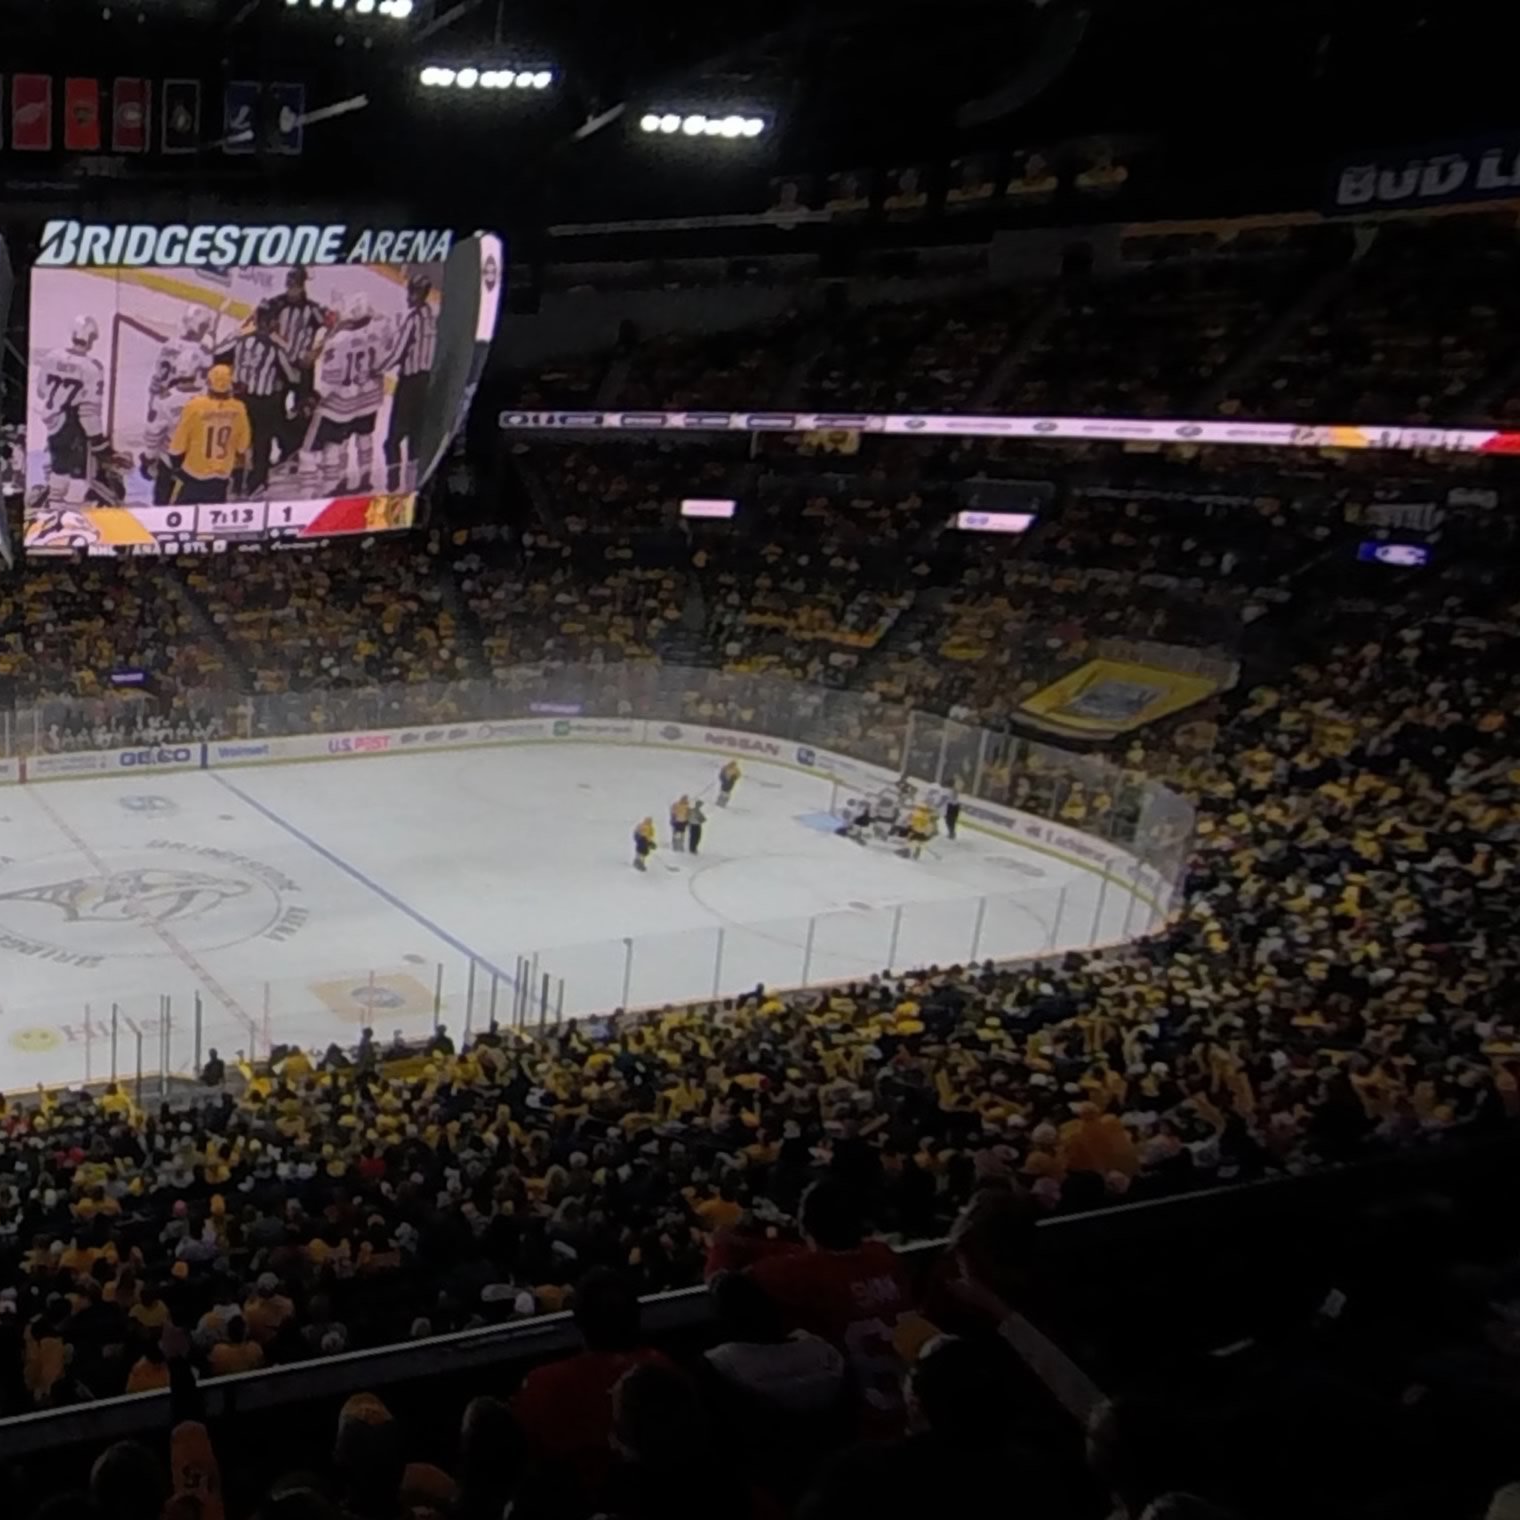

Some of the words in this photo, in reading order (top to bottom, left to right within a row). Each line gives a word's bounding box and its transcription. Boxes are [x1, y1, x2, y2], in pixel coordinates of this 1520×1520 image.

[1335, 153, 1470, 206] BUD
[35, 220, 346, 266] BRIDGESTONE
[347, 229, 453, 263] ARENA
[46, 373, 84, 410] 77
[205, 425, 232, 460] 19
[166, 511, 183, 528] 0
[209, 509, 255, 526] 7:13
[704, 731, 781, 757] NISSAN
